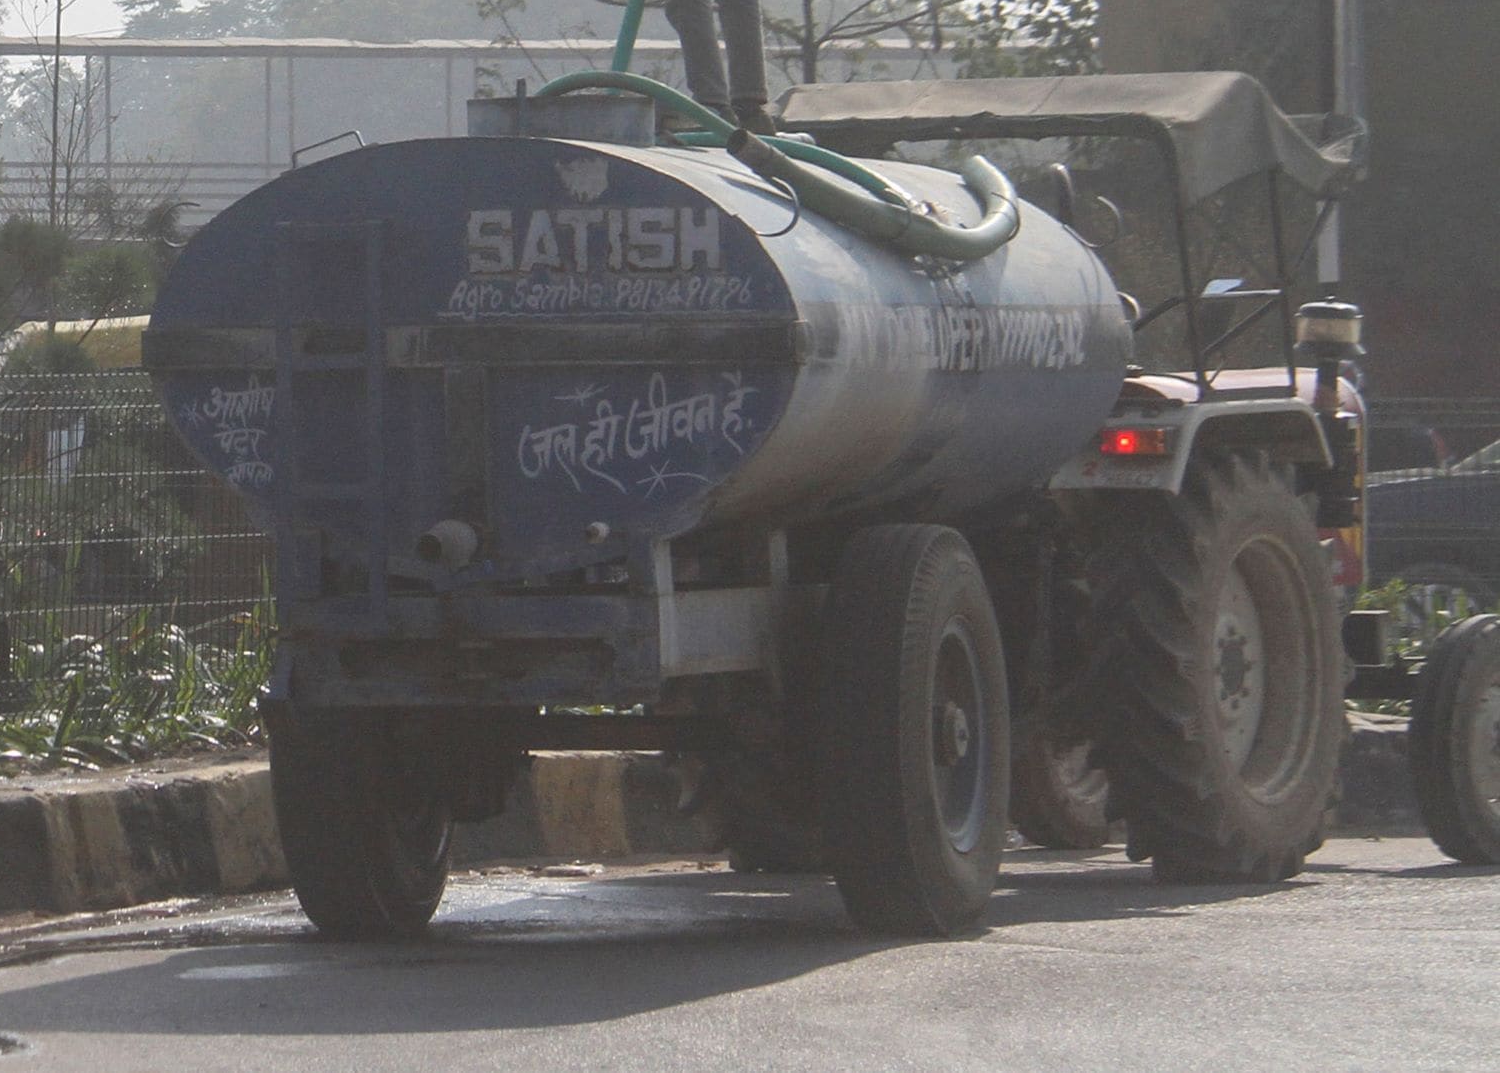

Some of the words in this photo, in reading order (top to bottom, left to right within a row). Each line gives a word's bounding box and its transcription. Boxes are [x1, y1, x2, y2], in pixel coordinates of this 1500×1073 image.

[467, 206, 722, 273] SATISH
[449, 279, 502, 320] Agro
[580, 398, 629, 495] ही
[625, 371, 716, 460] जीवन
